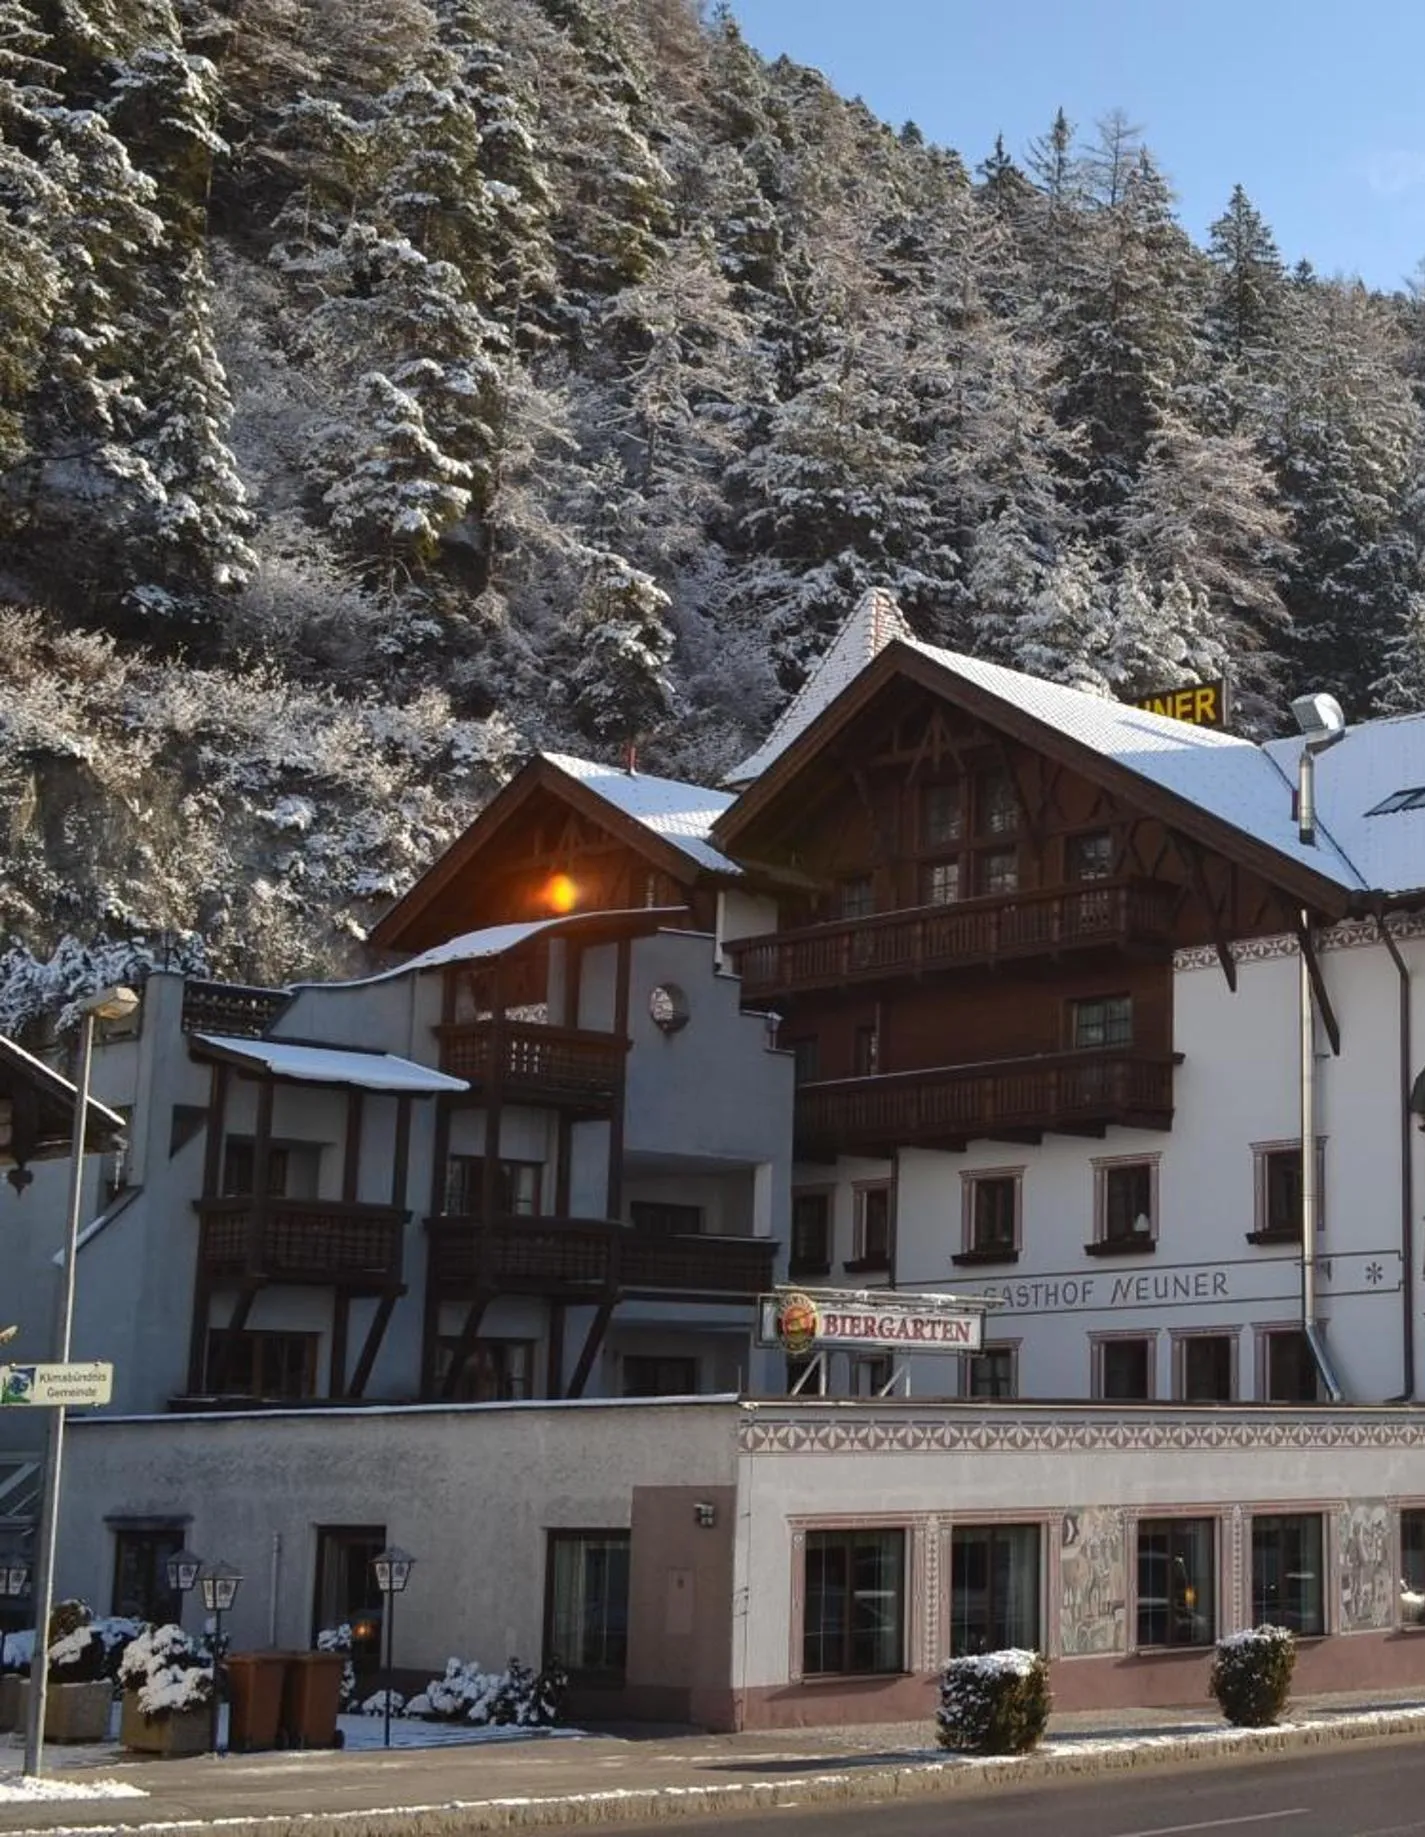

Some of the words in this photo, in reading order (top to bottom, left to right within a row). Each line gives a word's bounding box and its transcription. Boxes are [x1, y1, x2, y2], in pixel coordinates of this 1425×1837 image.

[983, 1280, 1094, 1309] GASTHOF
[1111, 1272, 1229, 1304] NEUNER
[823, 1314, 971, 1342] BIERGARTEN
[47, 1386, 97, 1397] Gemeinde
